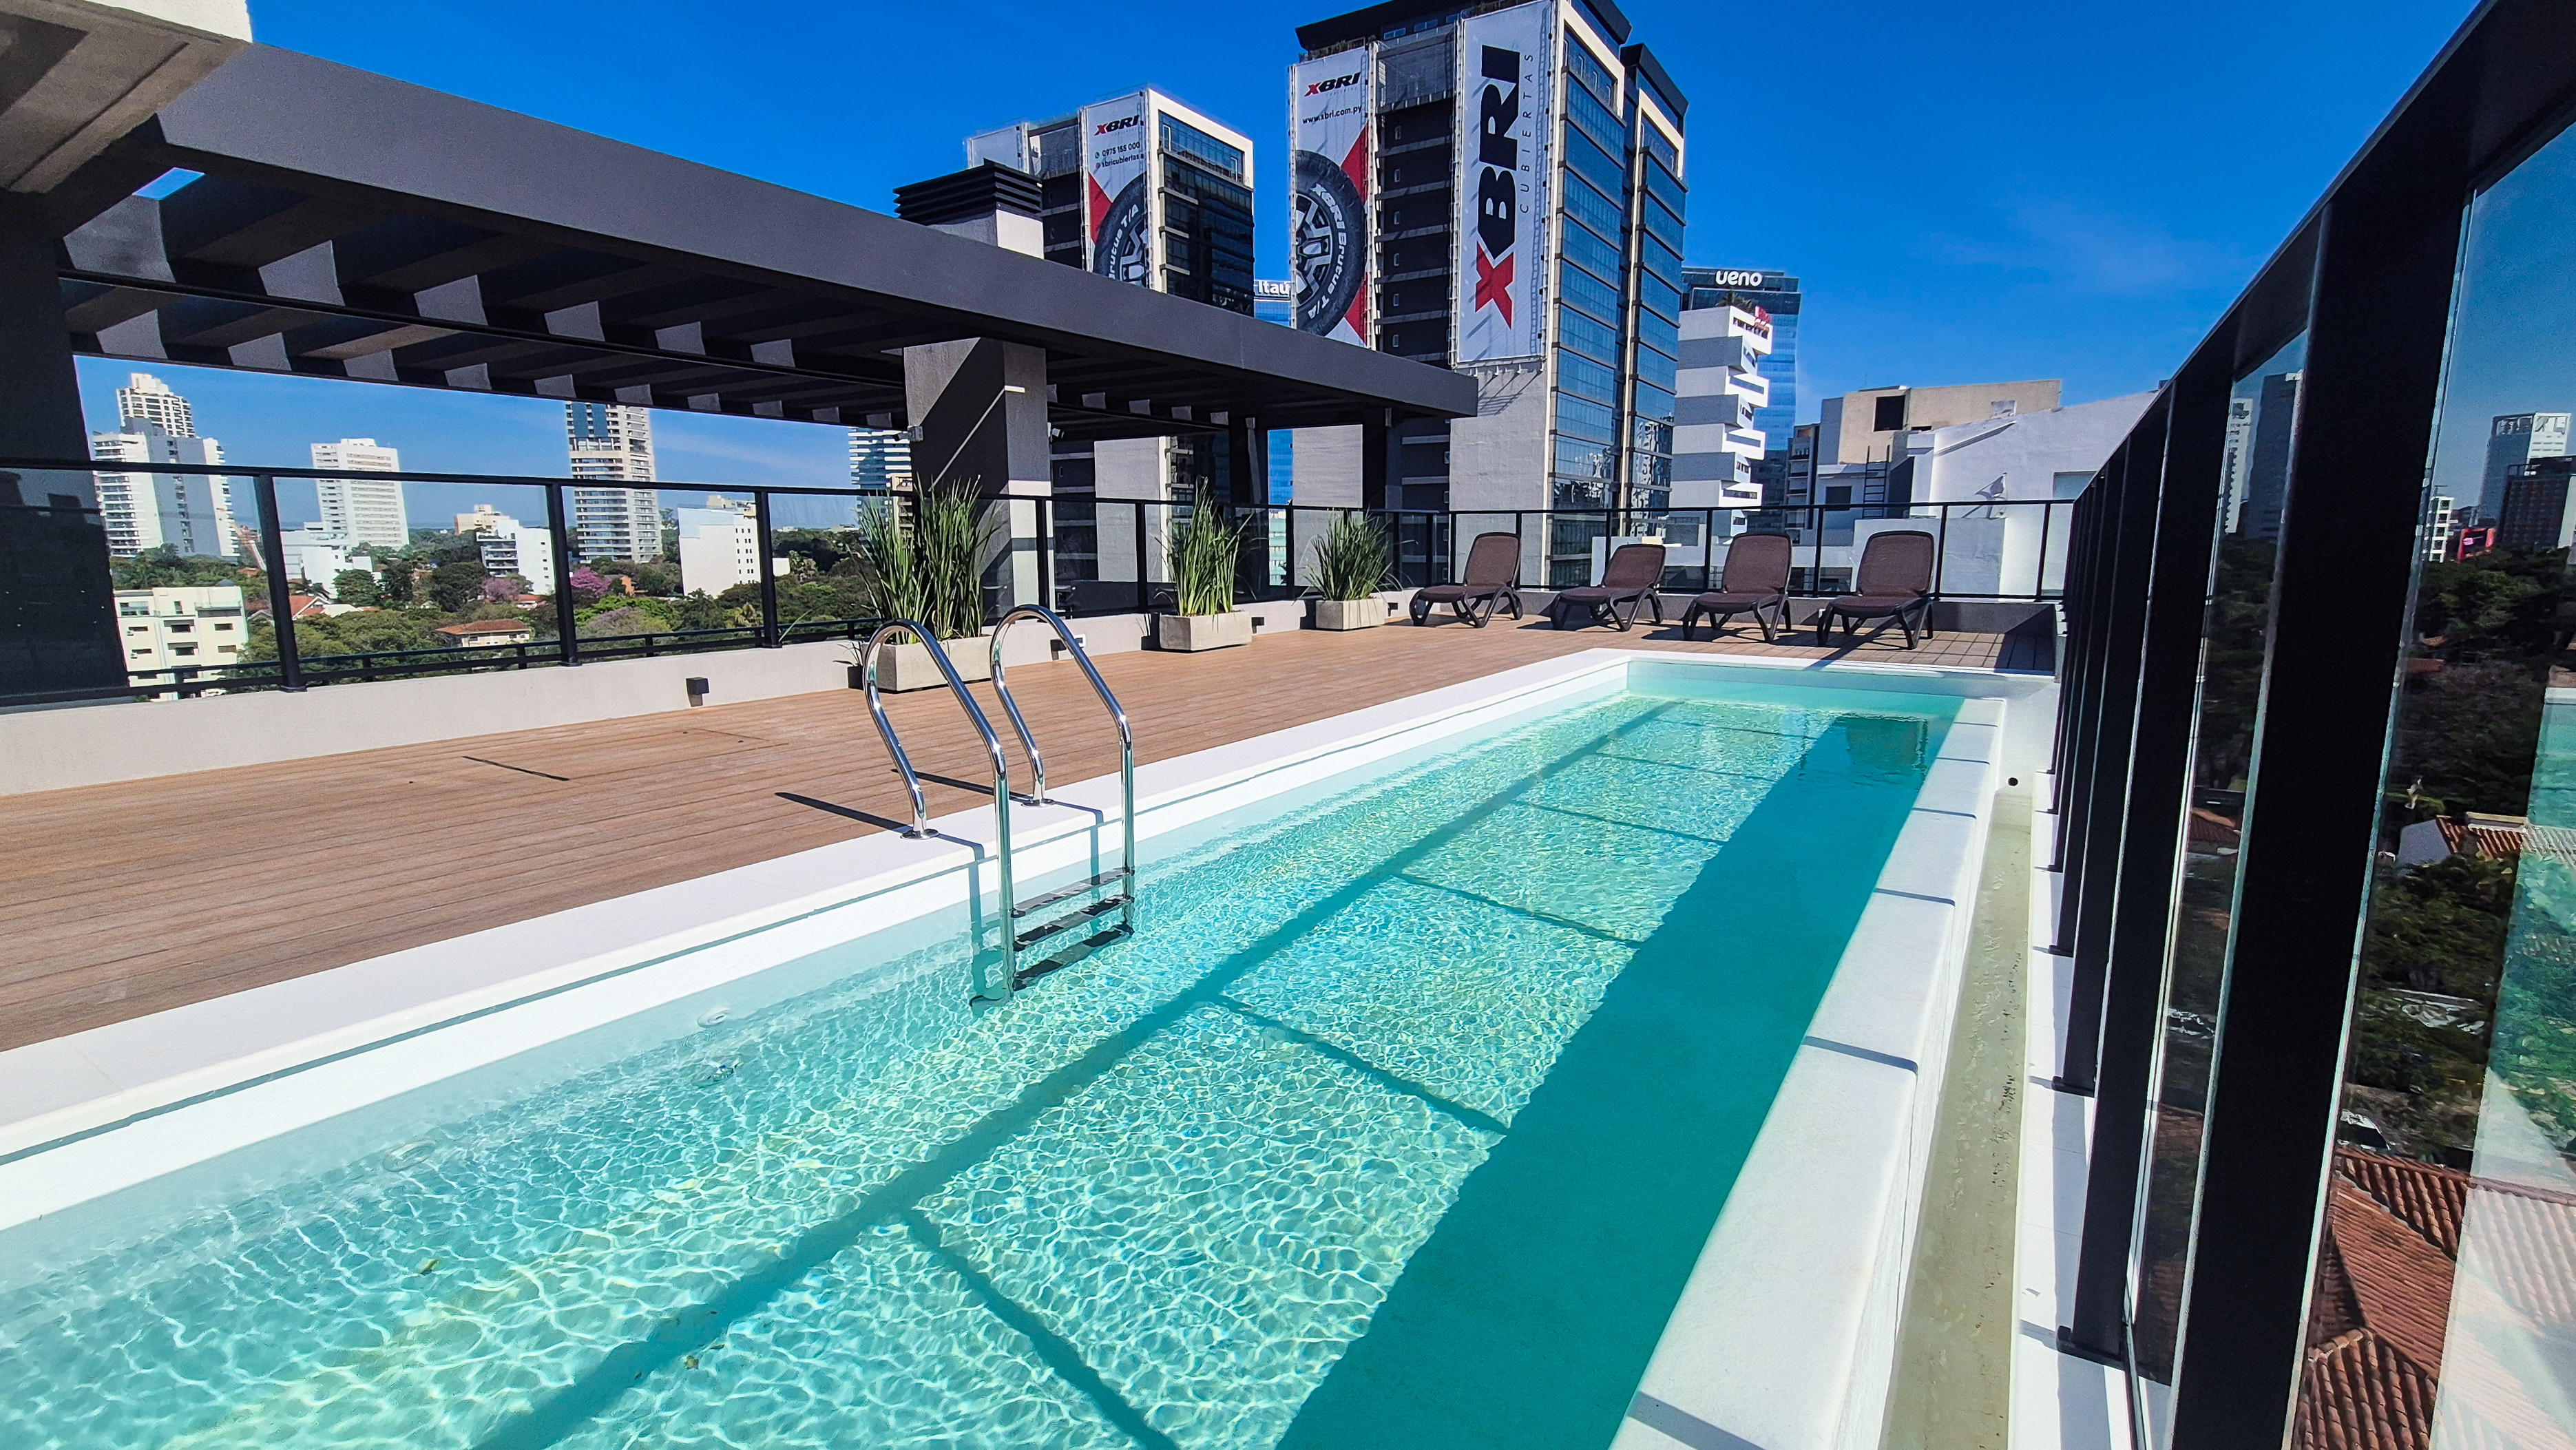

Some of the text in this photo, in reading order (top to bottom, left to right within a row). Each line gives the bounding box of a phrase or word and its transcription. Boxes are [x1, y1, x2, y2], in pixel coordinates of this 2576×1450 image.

[1304, 72, 1361, 96] XBRI
[1094, 114, 1140, 136] XBRI
[1302, 105, 1362, 124] www.xbri.com.py
[1520, 54, 1533, 213] CUBIERTAS
[1102, 141, 1140, 157] 0975 155 000
[1475, 45, 1520, 330] XBRI
[1308, 183, 1346, 319] XBRI Brutus T/A
[1715, 271, 1763, 286] ueno
